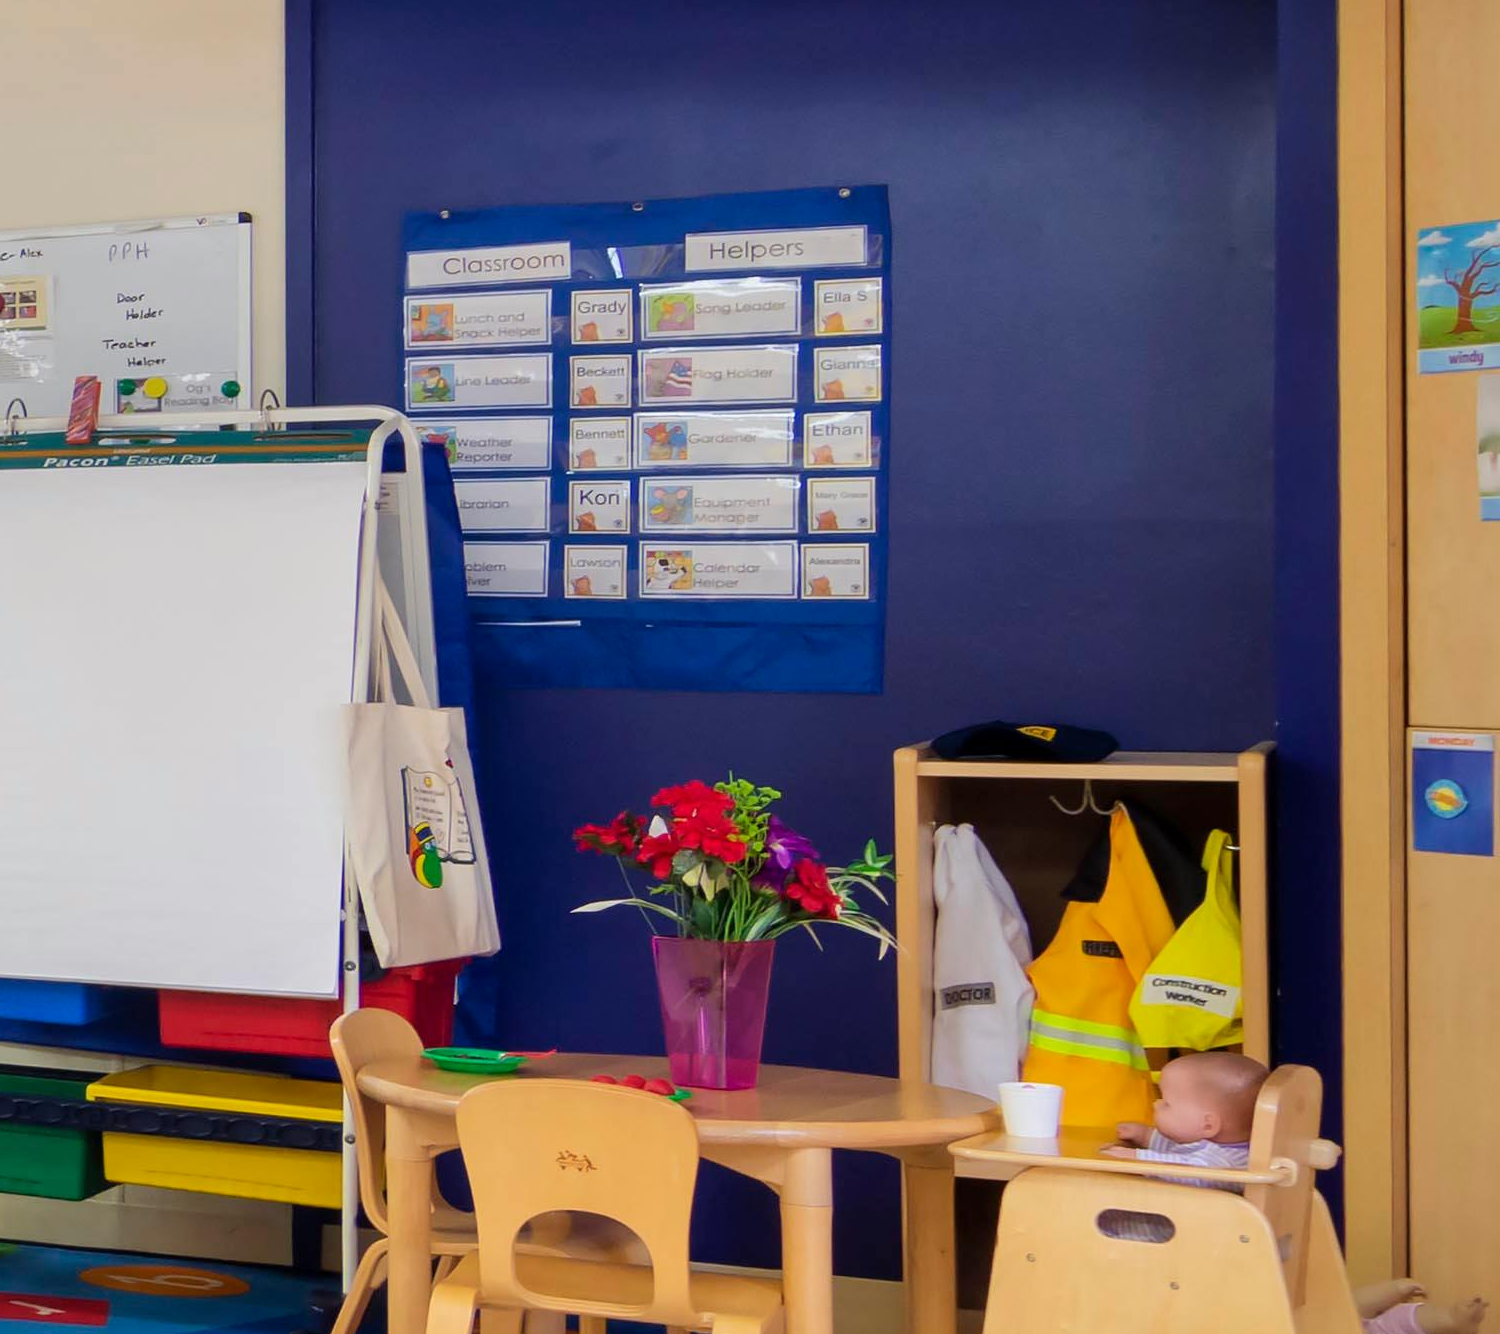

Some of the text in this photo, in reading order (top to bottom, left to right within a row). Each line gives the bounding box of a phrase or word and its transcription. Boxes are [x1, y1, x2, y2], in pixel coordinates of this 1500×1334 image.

[443, 241, 805, 275] Classroom Helpers
[117, 292, 146, 304] Door
[823, 290, 868, 304] Ella S
[578, 300, 626, 317] Grady
[695, 299, 787, 315] Song Leader
[125, 307, 165, 321] Holder
[454, 312, 525, 324] Lunch and
[455, 326, 541, 338] Snack Helper
[102, 338, 157, 350] Teacher
[1449, 349, 1485, 367] windy
[577, 366, 625, 378] Beckett
[726, 367, 774, 379] Holder
[455, 375, 531, 387] Line Leader
[164, 394, 211, 407] Reading
[575, 428, 625, 440] Bennett
[812, 423, 863, 437] Ethan
[456, 438, 512, 448] Weather
[43, 454, 217, 468] Pacon Easel Pad
[456, 452, 512, 464] Reporter
[458, 499, 509, 510] ibrarian
[693, 496, 771, 509] Equipment
[693, 512, 759, 524] Manager
[570, 558, 621, 568] Lawson
[693, 562, 761, 574] Calendar
[693, 577, 740, 589] Helper
[1151, 977, 1227, 997] Construction
[944, 987, 992, 1005] DOCTOR
